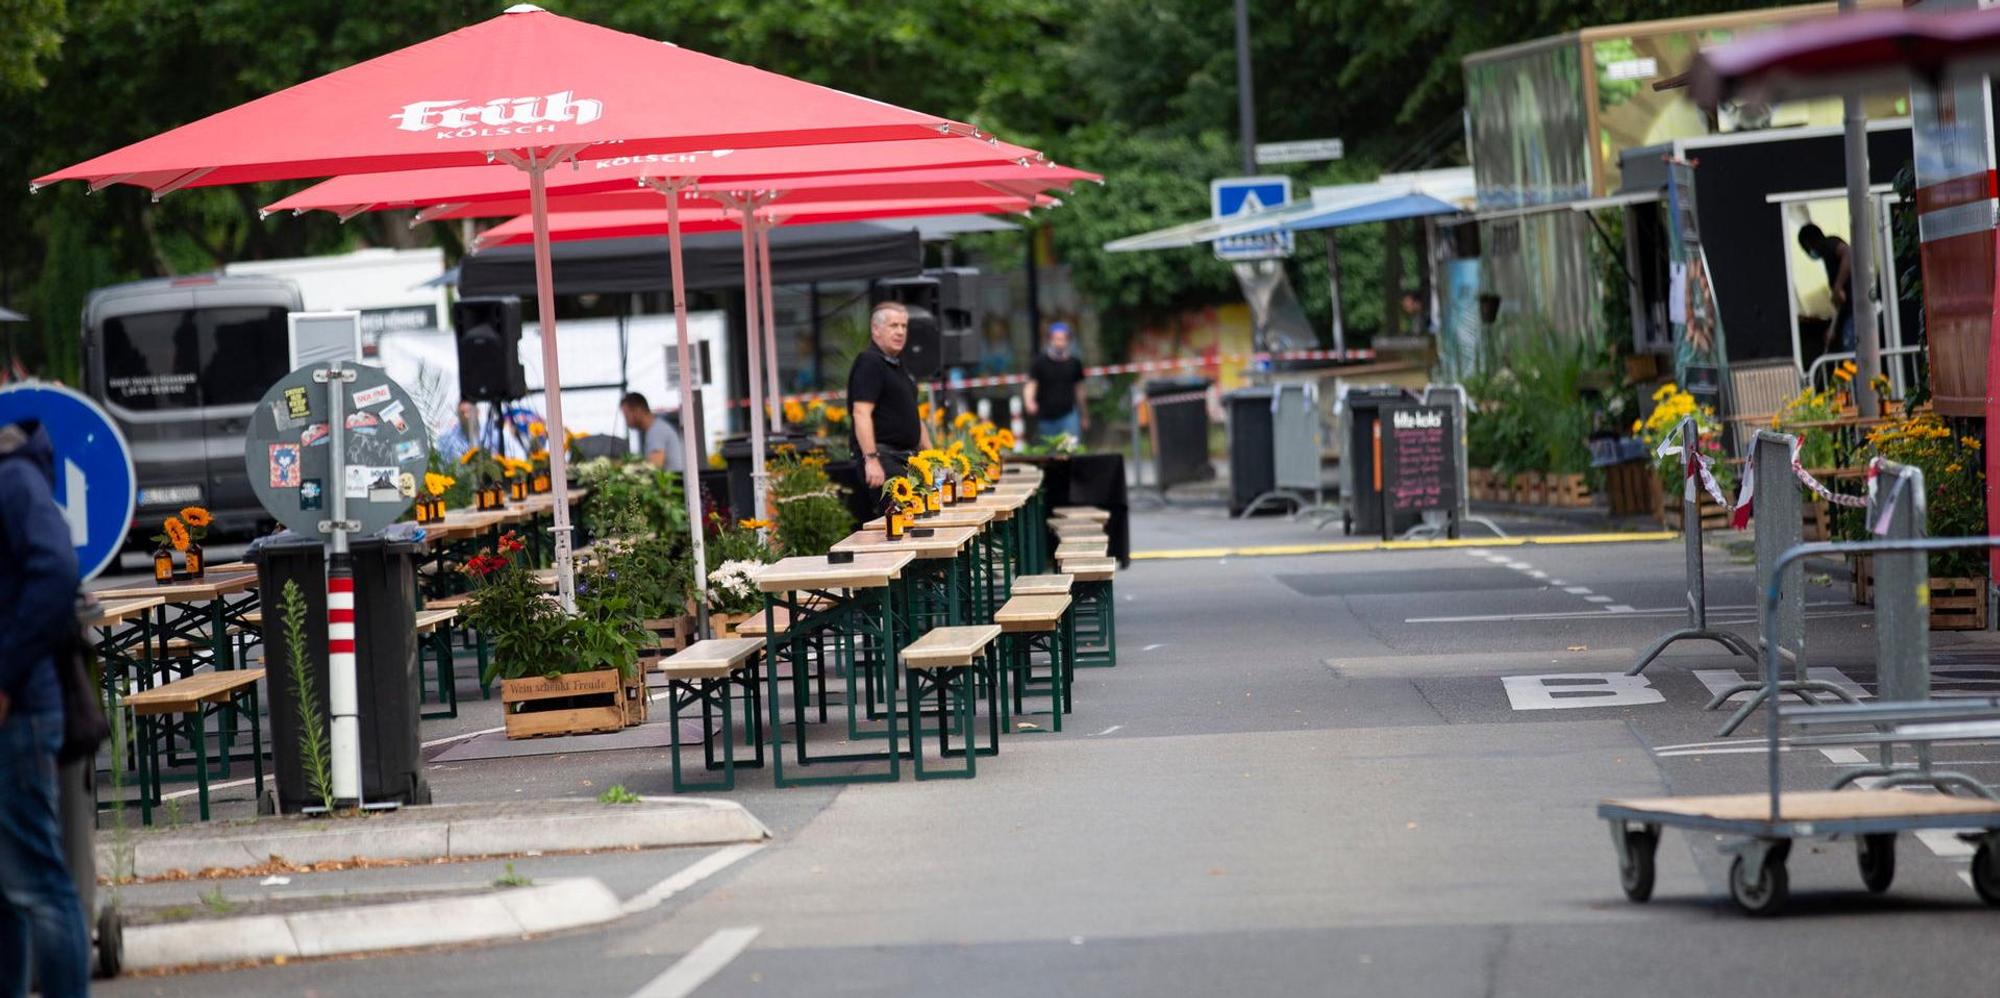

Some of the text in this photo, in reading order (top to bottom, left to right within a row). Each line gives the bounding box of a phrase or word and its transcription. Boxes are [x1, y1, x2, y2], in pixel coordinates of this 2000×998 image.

[389, 90, 603, 132] Früh
[436, 124, 555, 139] KÖLSCH
[510, 678, 607, 694] Wein schenkt Freude
